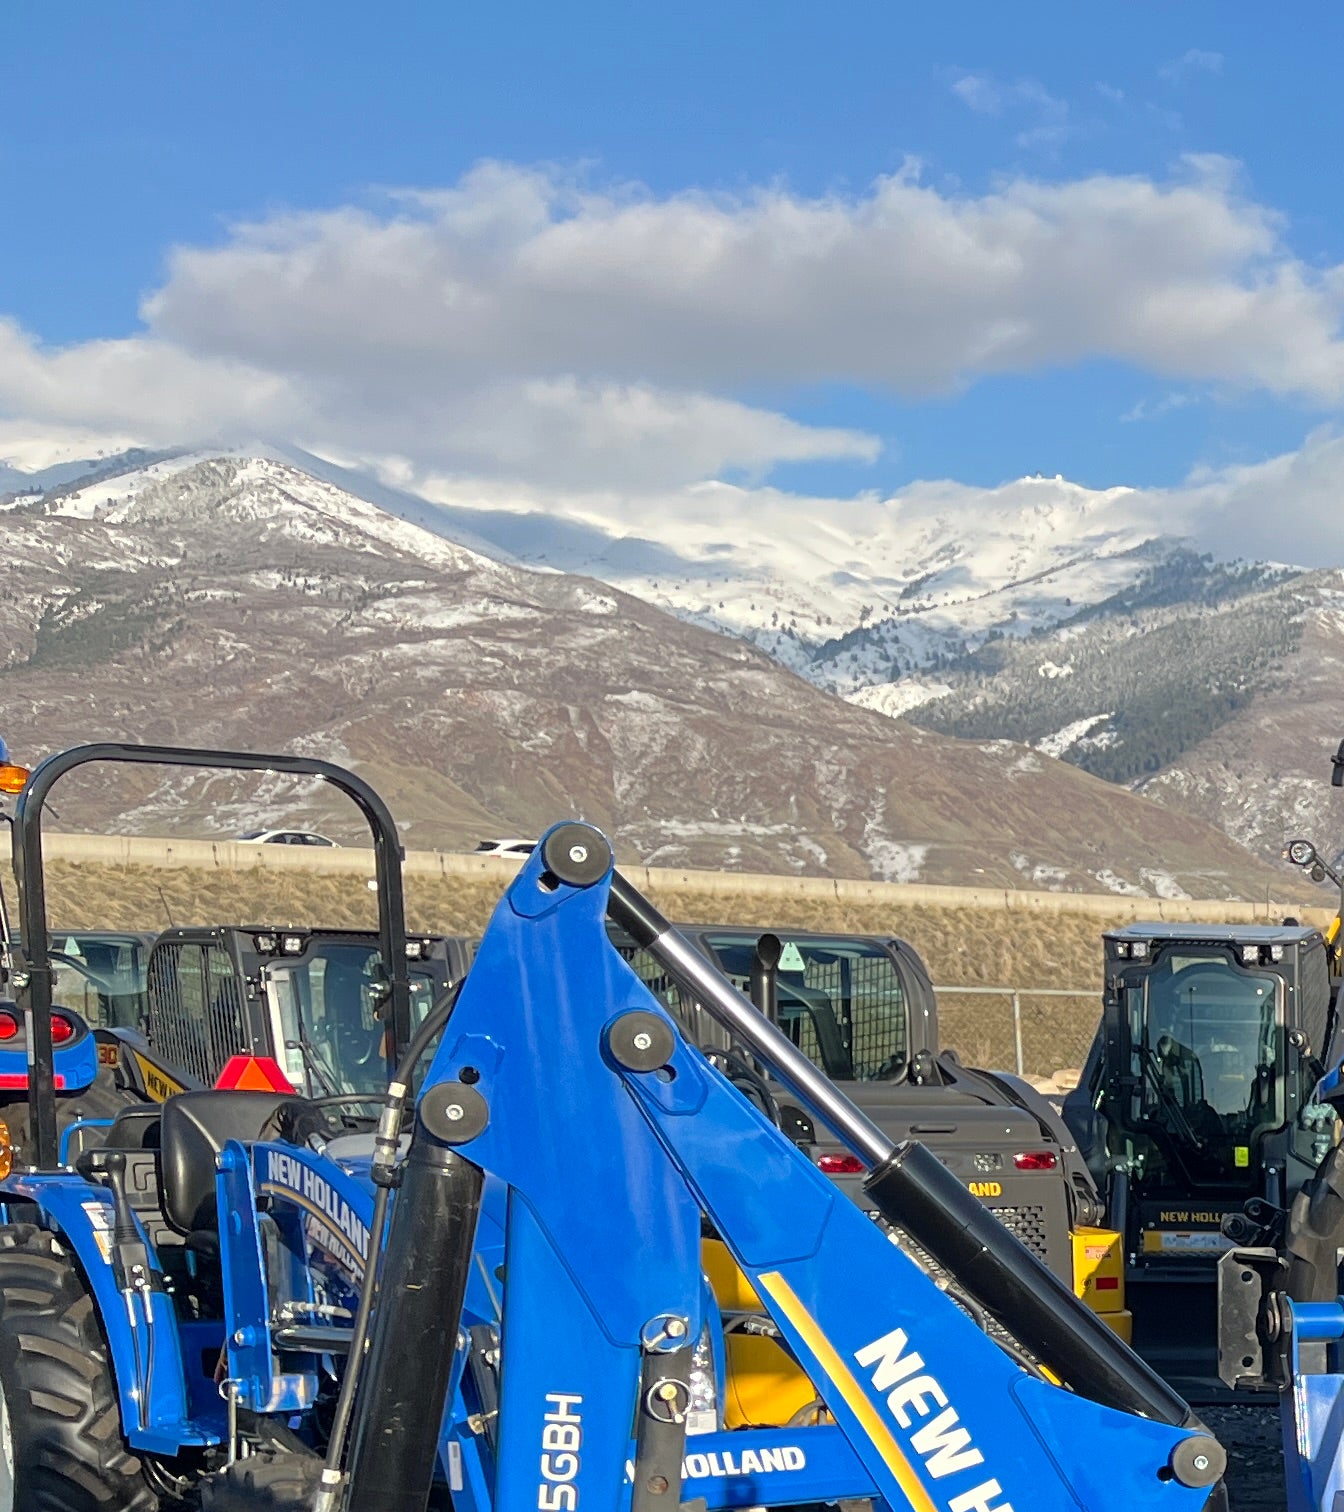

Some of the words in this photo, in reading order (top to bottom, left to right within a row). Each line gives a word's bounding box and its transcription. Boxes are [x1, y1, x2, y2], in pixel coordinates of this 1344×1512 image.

[268, 1150, 302, 1190] NEW
[1160, 1211, 1189, 1223] NEW
[1191, 1212, 1222, 1223] HOLL
[853, 1326, 985, 1480] NEW
